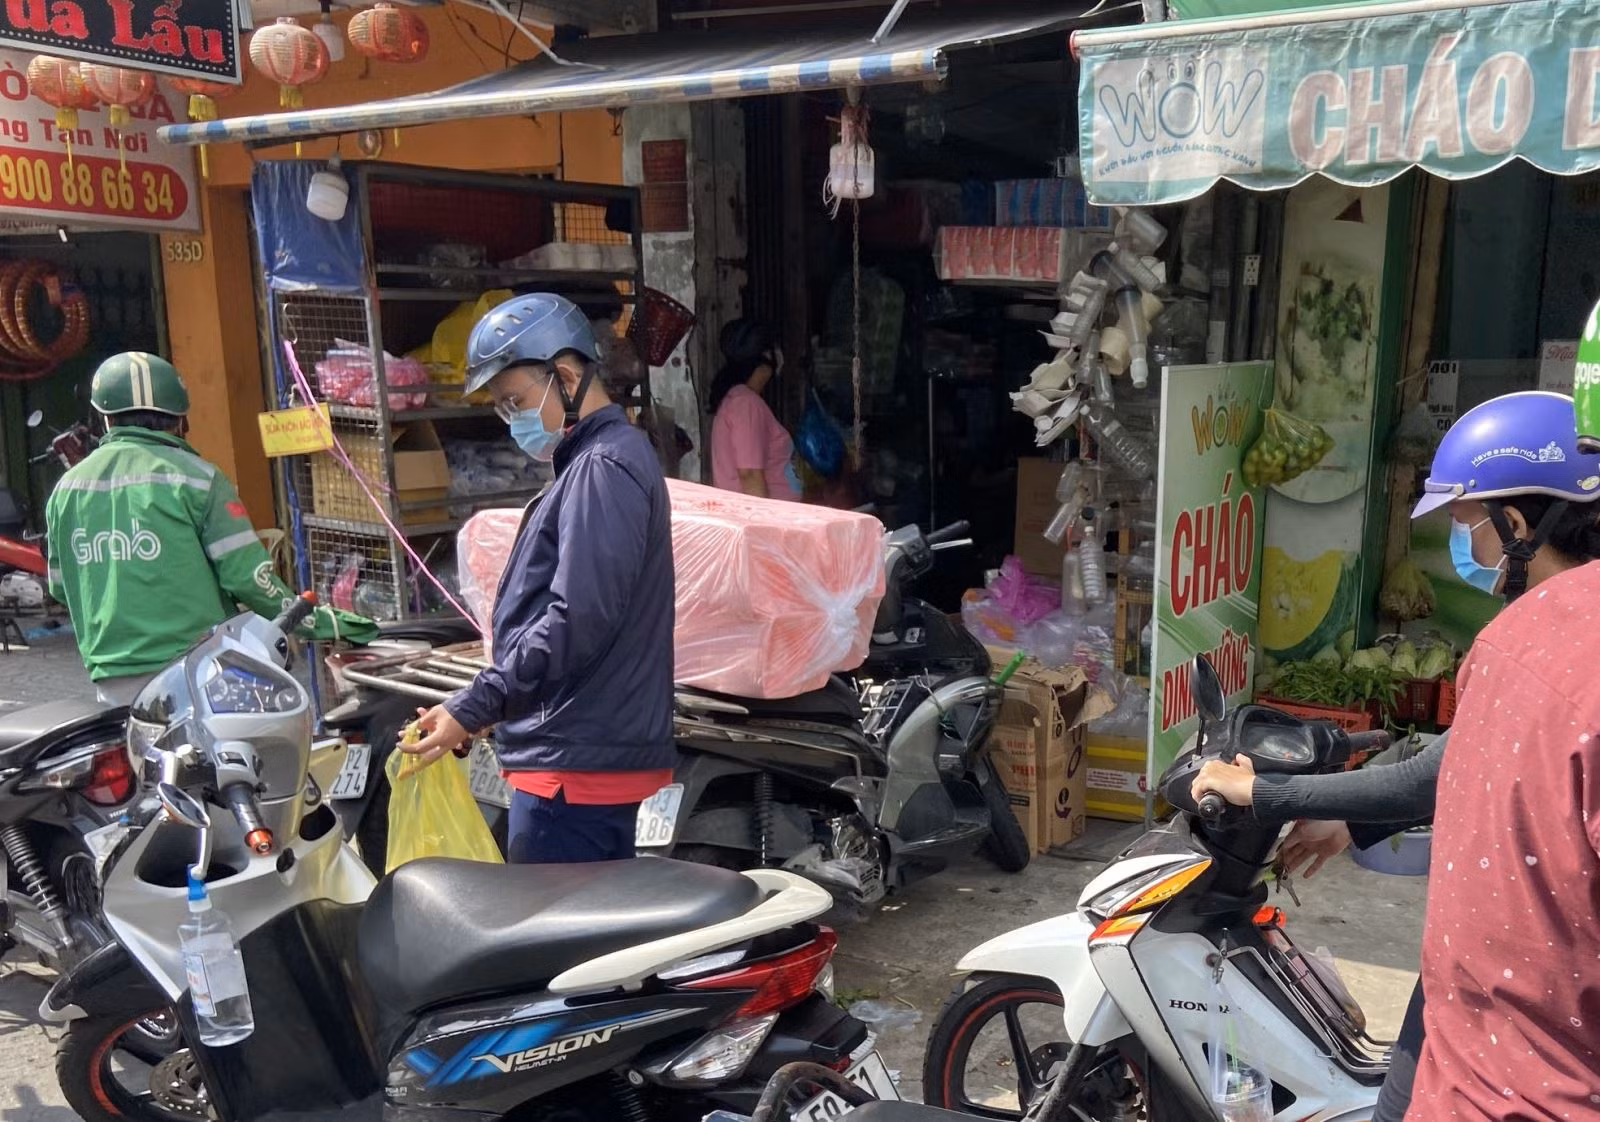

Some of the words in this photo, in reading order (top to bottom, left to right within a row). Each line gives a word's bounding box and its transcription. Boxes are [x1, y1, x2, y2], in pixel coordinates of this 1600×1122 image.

[1288, 32, 1536, 170] CHÁO
[60, 163, 94, 207] 88
[103, 166, 135, 211] 66
[142, 171, 175, 214] 34
[167, 241, 203, 262] 535D
[1191, 394, 1251, 456] WOW
[1471, 450, 1493, 467] Have
[1500, 446, 1519, 454] safe
[1519, 448, 1538, 460] ride
[71, 517, 162, 565] Grab
[1170, 470, 1255, 619] CHÁO
[471, 1024, 622, 1073] VISION
[514, 1054, 567, 1072] HELMET-IN
